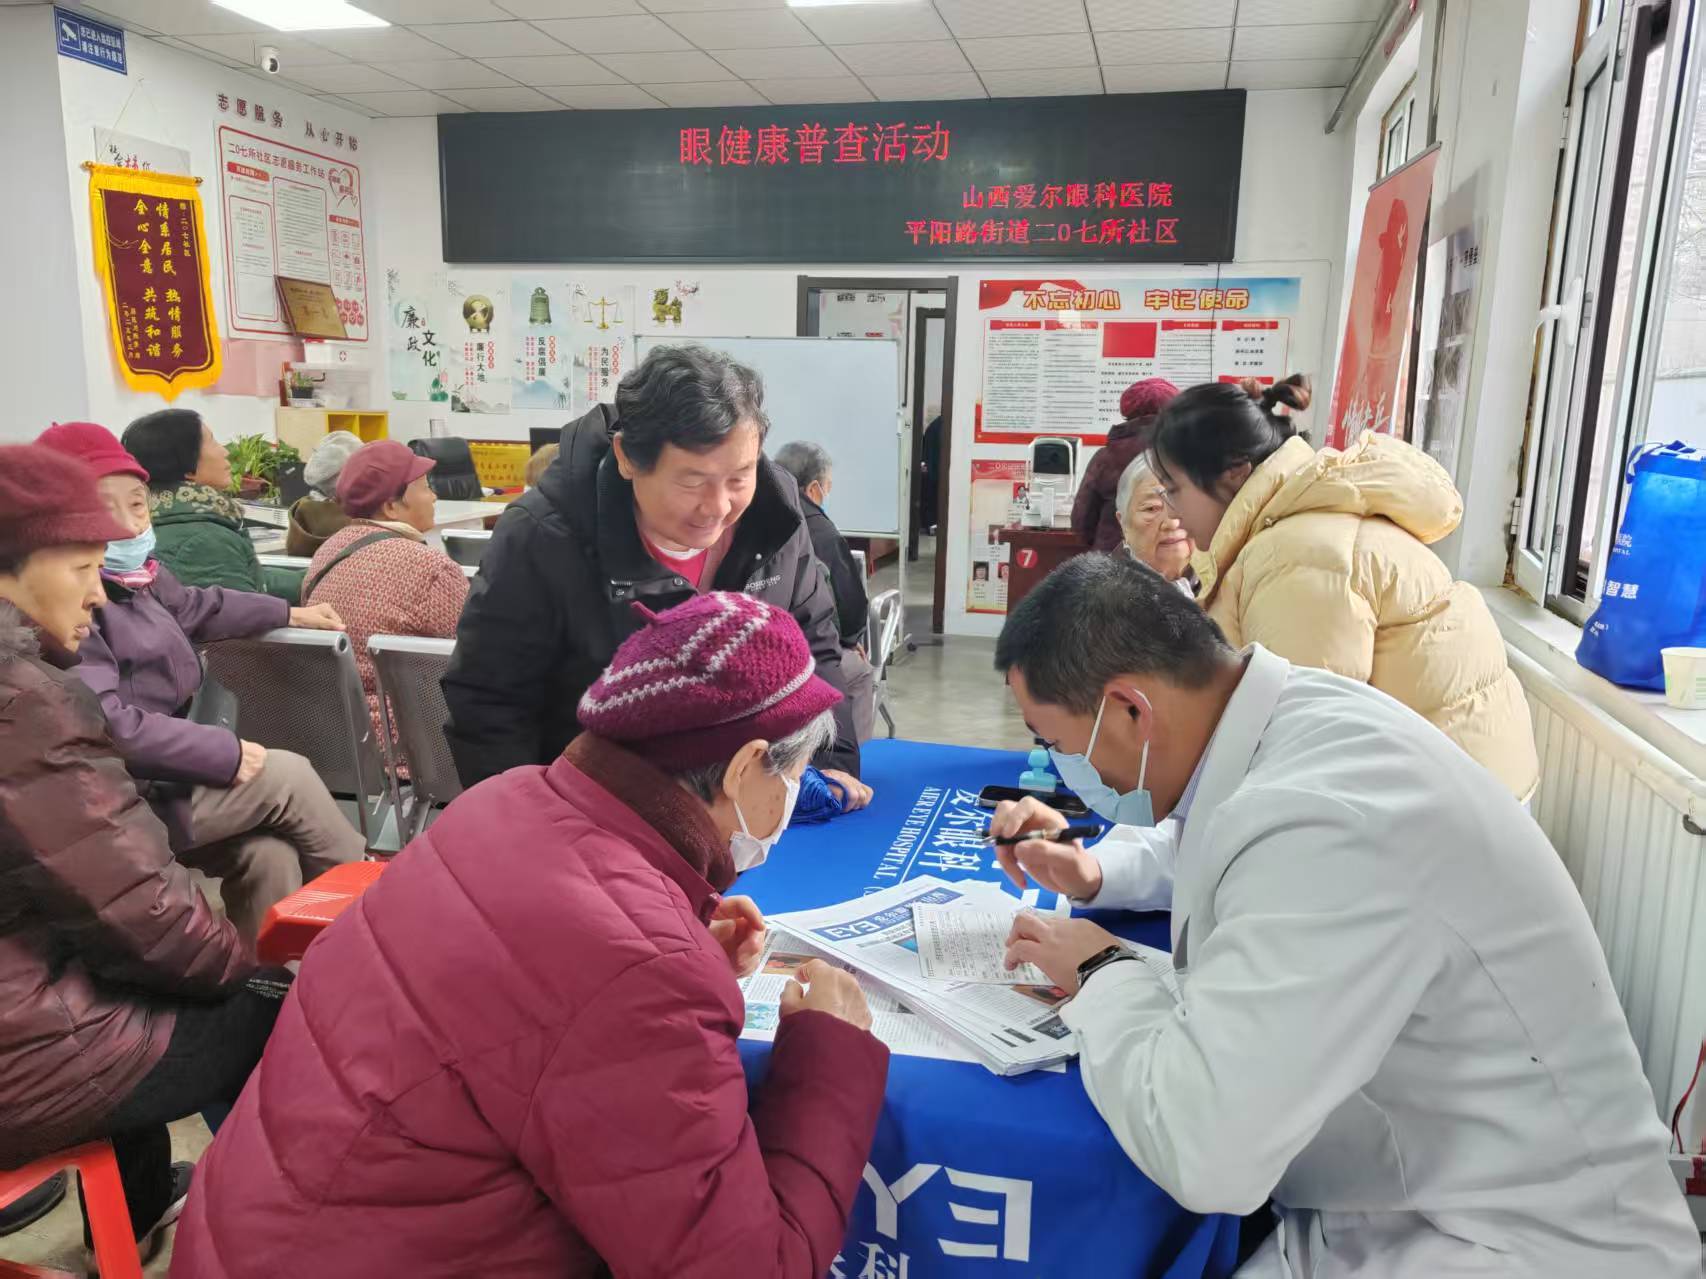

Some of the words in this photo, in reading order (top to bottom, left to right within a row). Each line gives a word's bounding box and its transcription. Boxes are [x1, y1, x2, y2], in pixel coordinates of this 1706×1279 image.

[218, 93, 283, 128] 志愿服务
[305, 120, 358, 151] 从心开始
[679, 121, 951, 166] 眼健康普查活动
[962, 181, 1174, 209] 山西爱尔眼科医院
[156, 202, 177, 275] 情系居民
[133, 199, 153, 274] 全心全意
[143, 286, 160, 357] 共筑和谐
[1023, 288, 1121, 310] 不忘初心
[1144, 288, 1249, 310] 牢记使命
[165, 288, 183, 358] 热情服务
[422, 330, 437, 367] 文化
[601, 347, 609, 388] 为民服务
[1021, 549, 1034, 567] 7
[1602, 580, 1639, 600] 智慧
[905, 807, 932, 827] EYE
[915, 786, 942, 807] AIER
[873, 827, 922, 880] HOSPITAL
[862, 1161, 1033, 1262] YE
